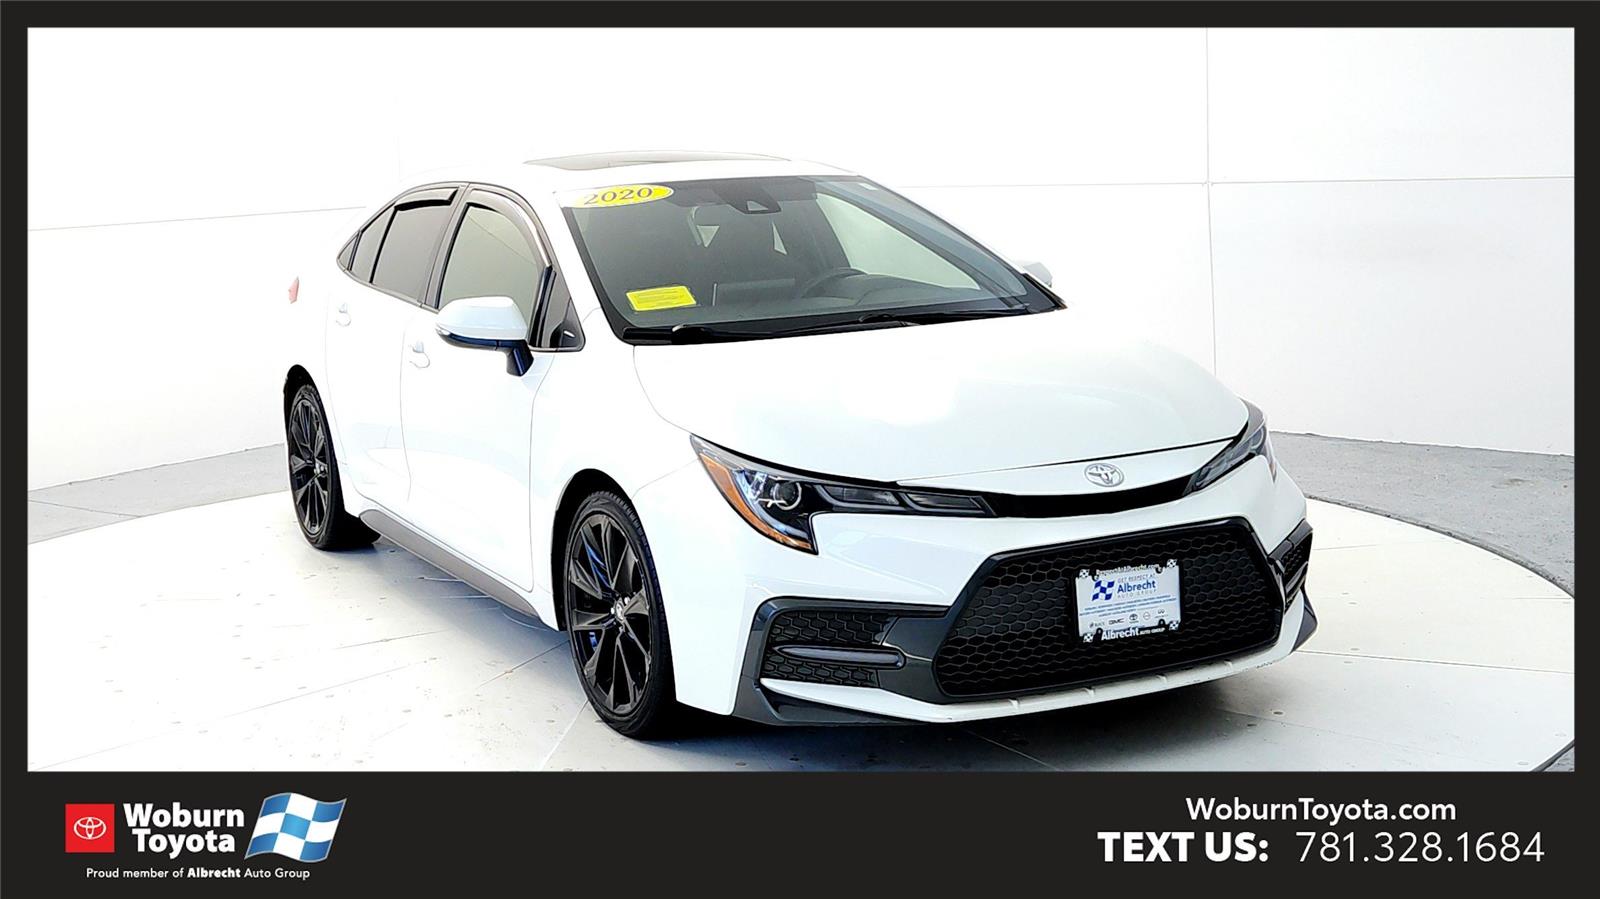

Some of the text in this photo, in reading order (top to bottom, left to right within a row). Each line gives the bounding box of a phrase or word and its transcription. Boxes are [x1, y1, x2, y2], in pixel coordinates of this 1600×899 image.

[584, 187, 653, 205] 2020
[1117, 580, 1156, 593] Albrecht
[1101, 627, 1139, 641] Albrecht
